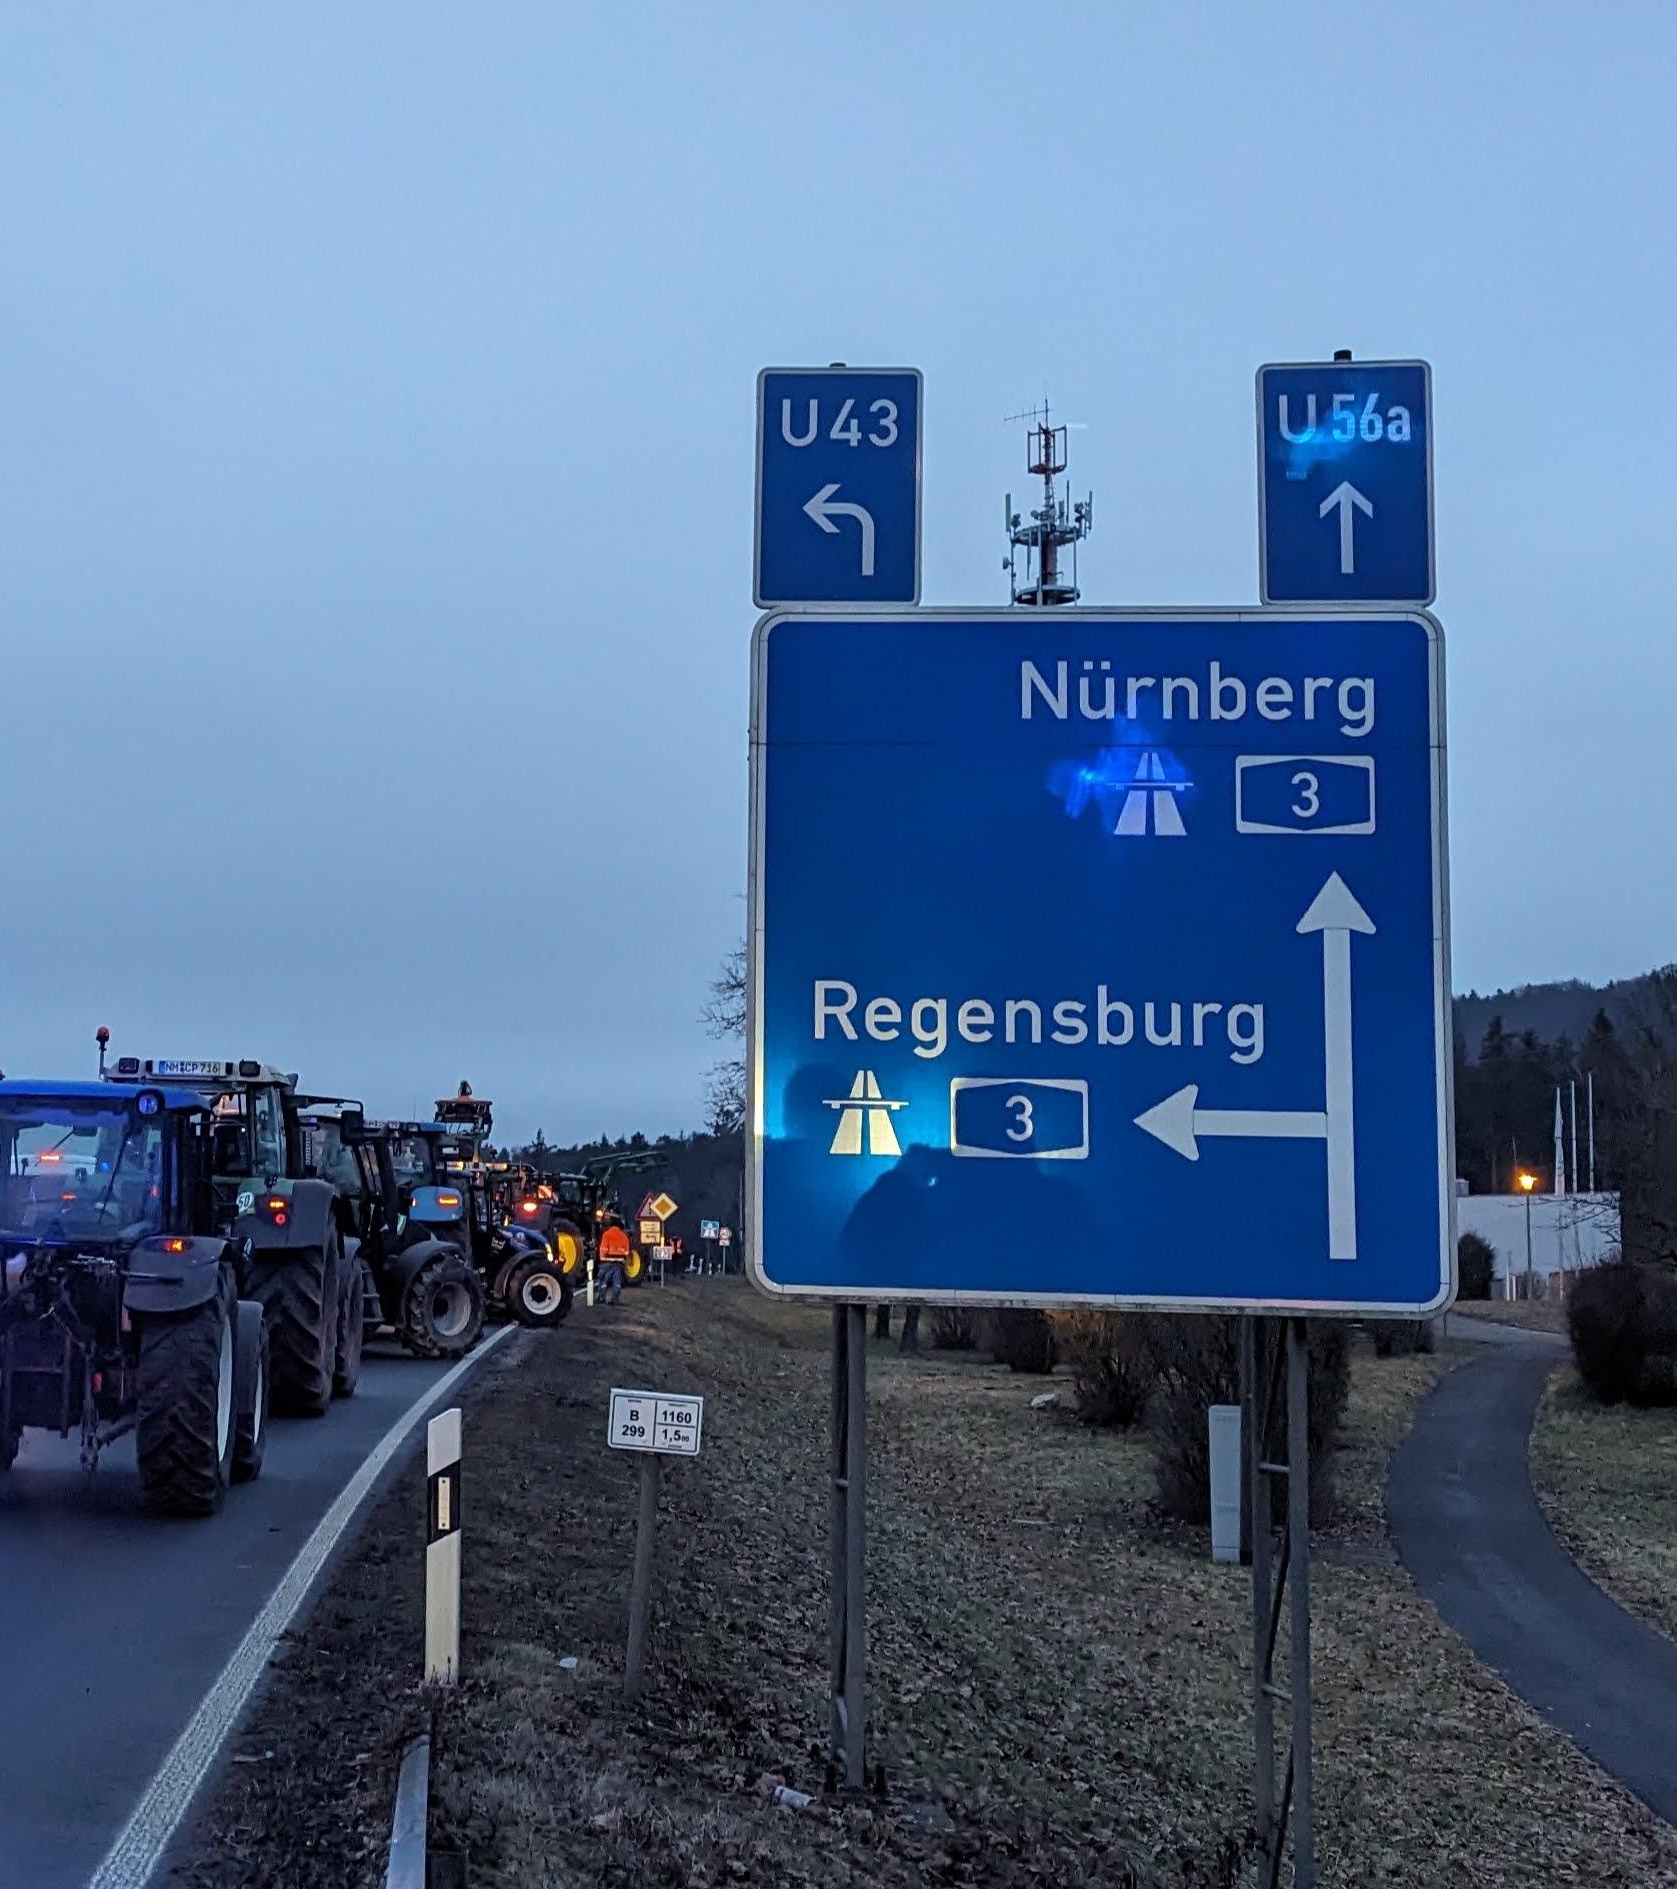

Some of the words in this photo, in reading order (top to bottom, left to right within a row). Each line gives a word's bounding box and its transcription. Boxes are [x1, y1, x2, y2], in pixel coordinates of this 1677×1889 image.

[782, 398, 818, 447] U
[829, 398, 898, 447] 43
[1278, 393, 1317, 443] U
[1332, 393, 1411, 442] 56a
[1021, 660, 1375, 738] Nürnberg
[1291, 771, 1320, 818] 3
[814, 980, 1264, 1065] Regensburg
[1005, 1095, 1033, 1142] 3
[621, 1424, 645, 1438] 299
[629, 1409, 640, 1421] B
[662, 1410, 692, 1424] 1160
